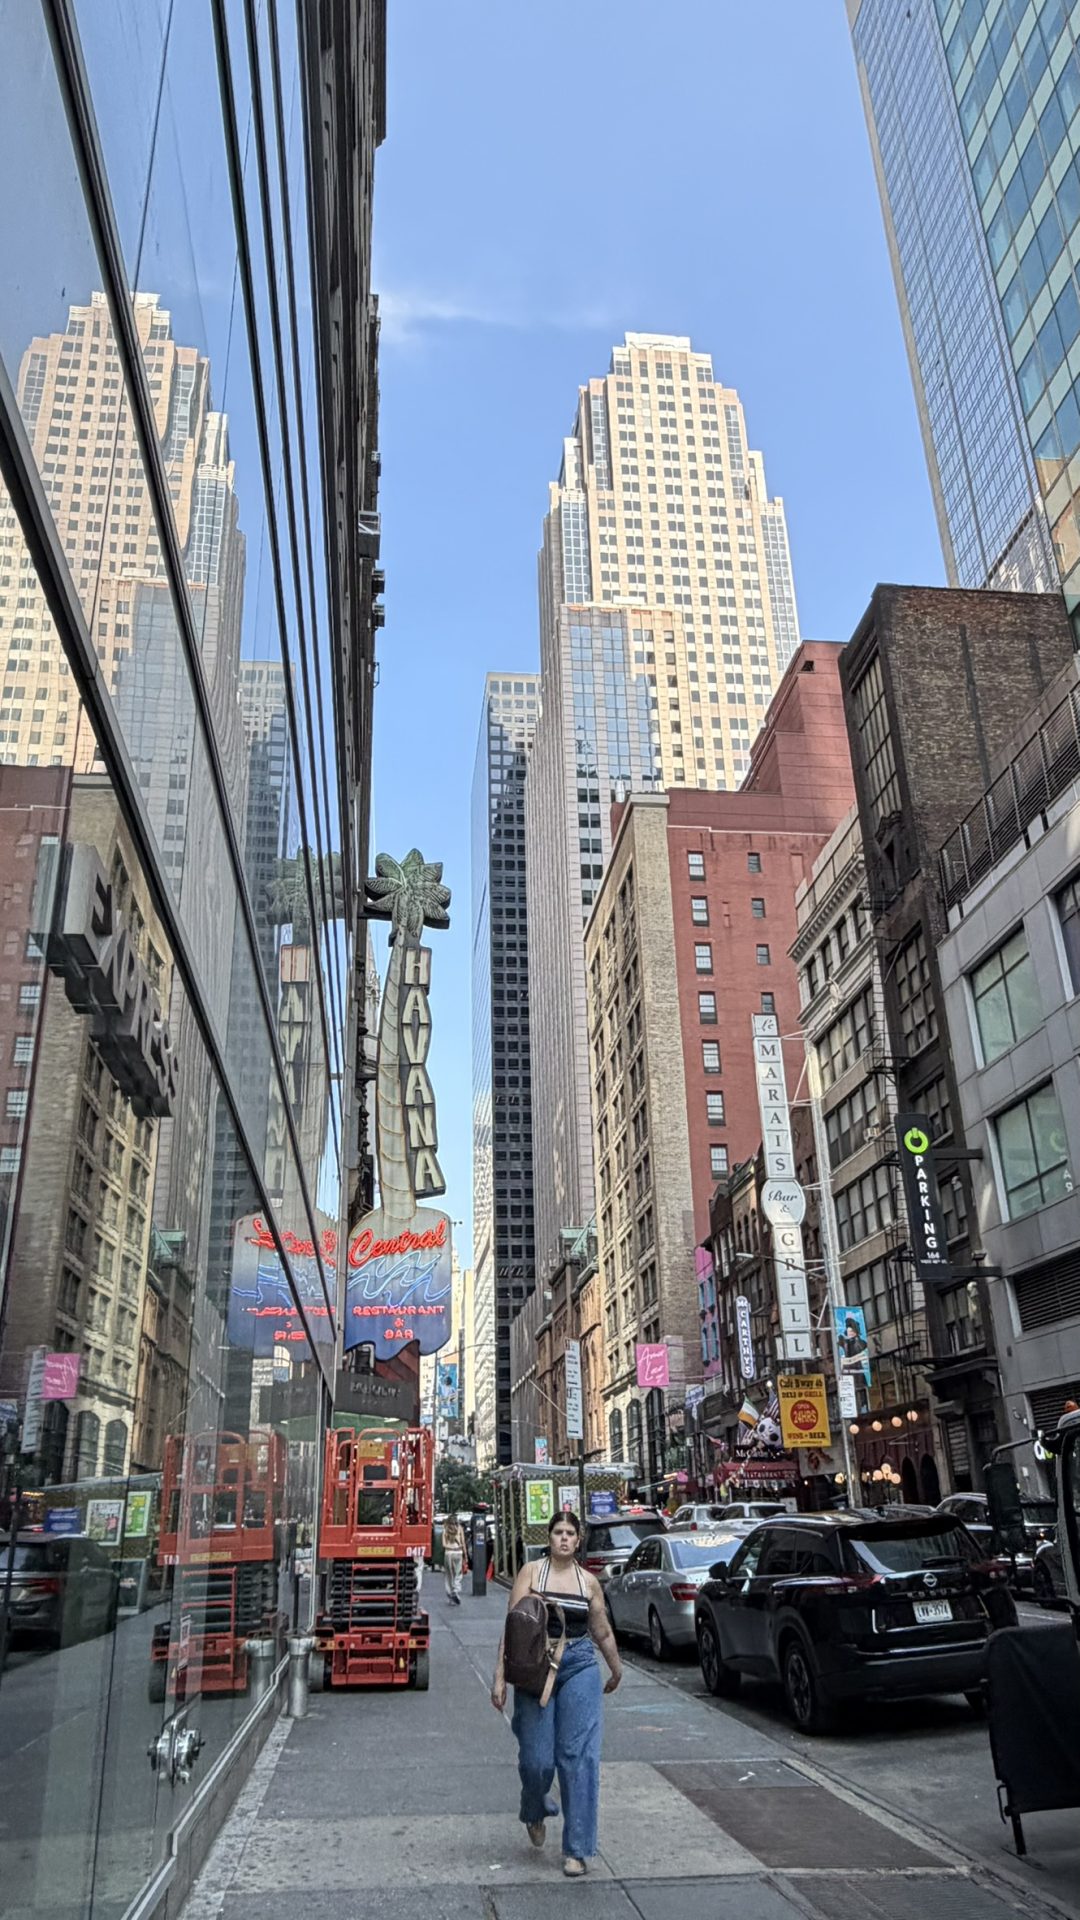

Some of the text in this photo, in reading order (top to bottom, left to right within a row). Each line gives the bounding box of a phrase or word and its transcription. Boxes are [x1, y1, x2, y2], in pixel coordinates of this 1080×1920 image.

[401, 949, 444, 1191] HAVANA
[760, 1044, 786, 1171] MARAIS
[768, 1190, 798, 1202] Bar
[914, 1154, 938, 1249] PARKING
[349, 1218, 447, 1267] Central
[353, 1305, 445, 1316] RESTAURANT
[780, 1232, 805, 1353] GRILL
[384, 1329, 414, 1340] BAR
